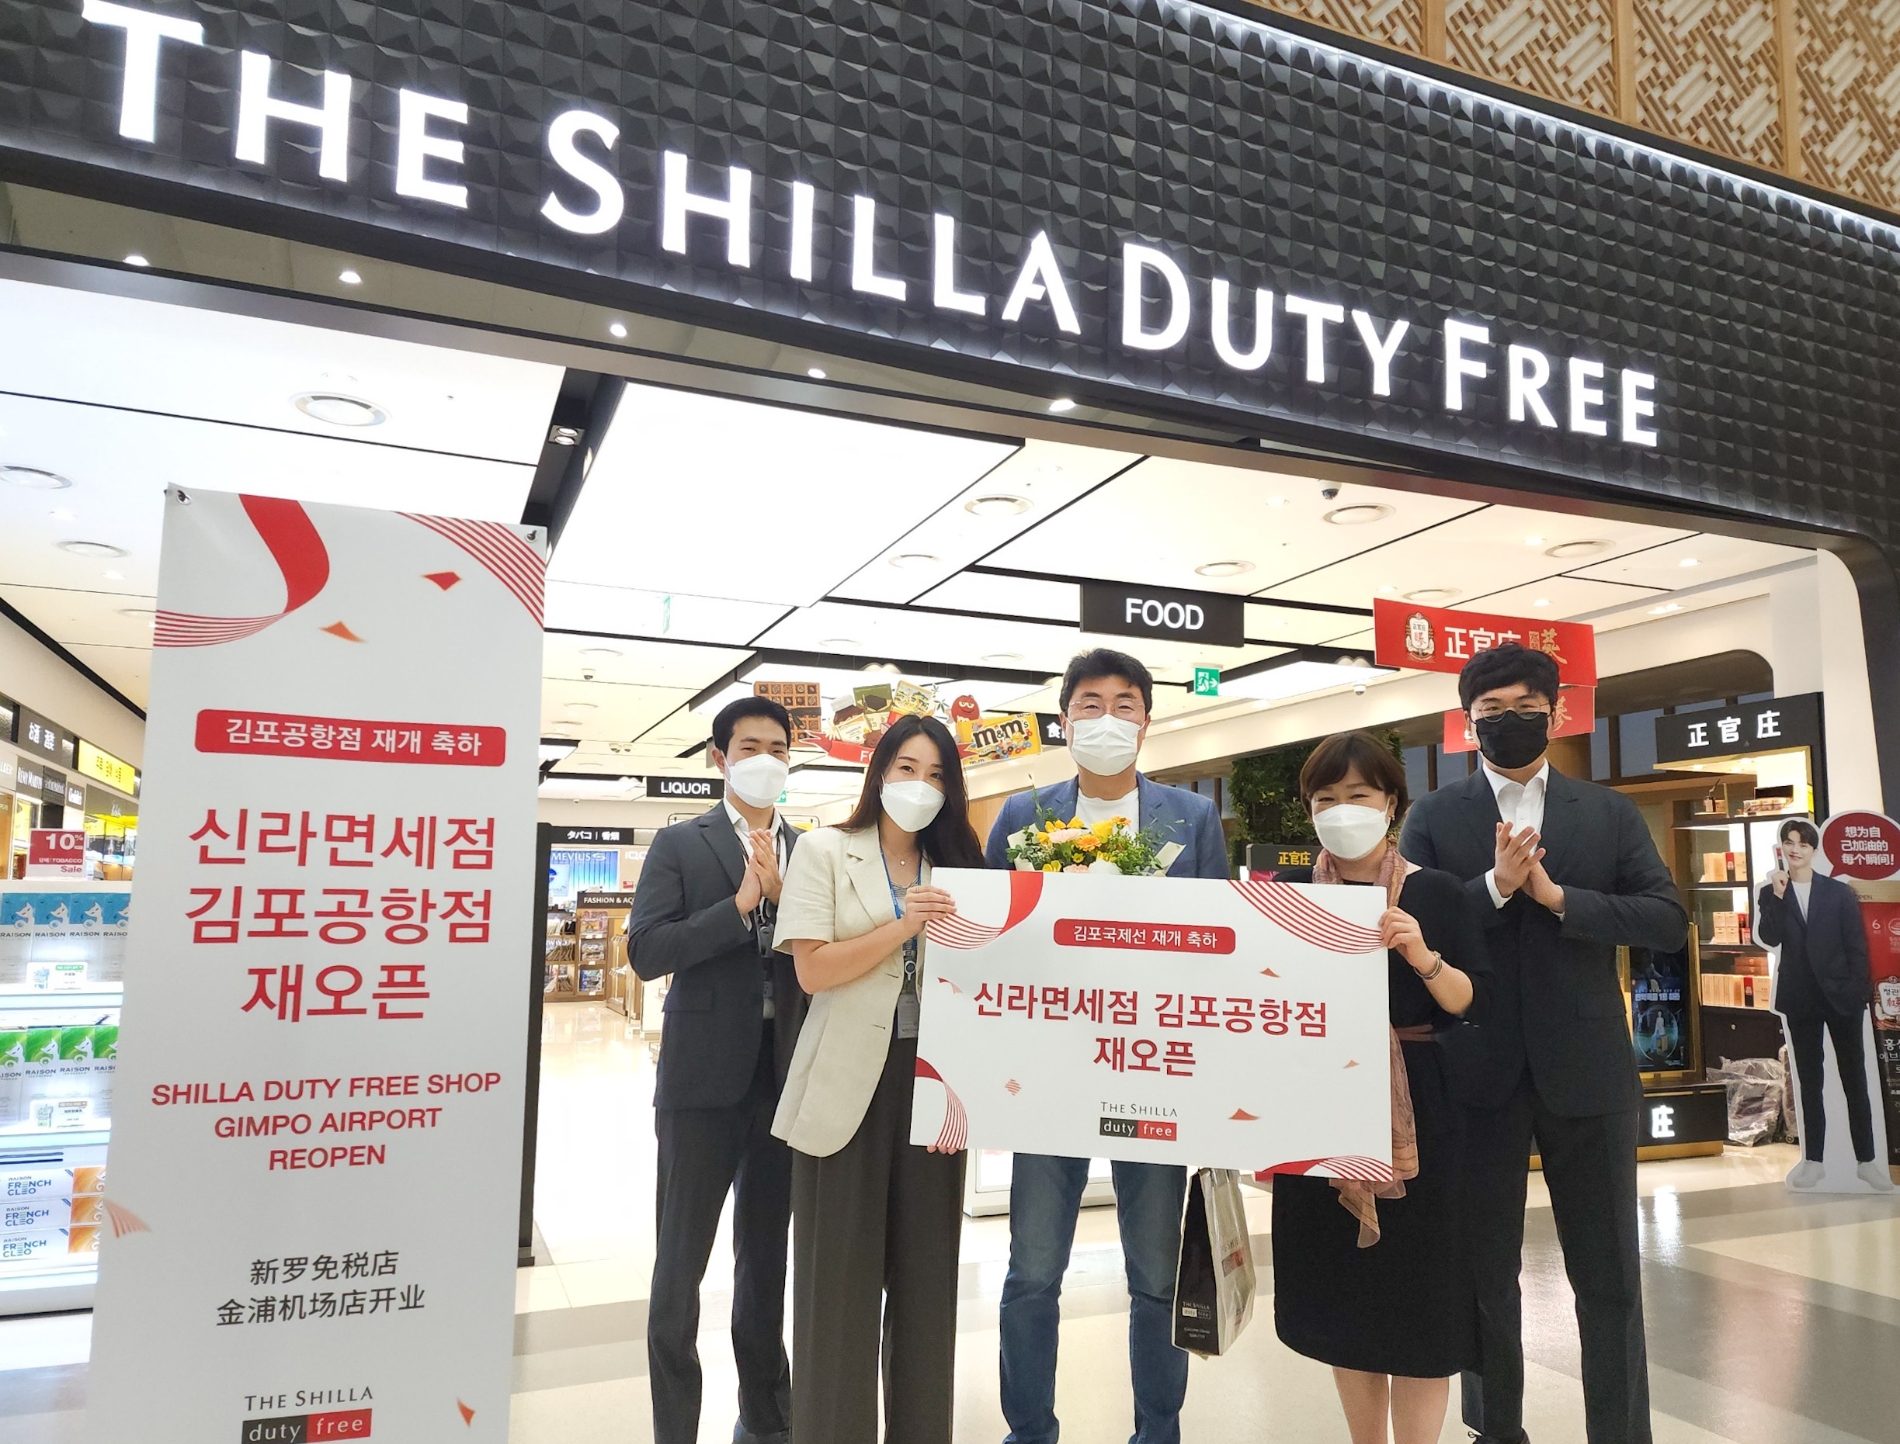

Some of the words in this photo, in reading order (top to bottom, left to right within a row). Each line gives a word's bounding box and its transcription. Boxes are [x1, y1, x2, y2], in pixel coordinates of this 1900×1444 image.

[82, 0, 468, 209] THE
[540, 110, 1082, 335] SHILLA
[1123, 243, 1410, 396] DUTY
[1444, 318, 1657, 447] FREE
[1125, 598, 1204, 631] FOOD
[226, 718, 362, 751] 김포공항점
[371, 728, 421, 754] 재개
[431, 731, 482, 757] 축하
[1046, 722, 1065, 739] 食
[1687, 710, 1781, 748] 正官庄
[661, 781, 711, 795] LIQUOR
[189, 808, 495, 870] 신라면세점
[567, 830, 592, 840] タバコ
[1845, 826, 1881, 838] 想为自
[1840, 840, 1888, 851] 己加油的
[551, 852, 591, 862] MEVIUS
[1841, 853, 1894, 865] 每个瞬间!
[185, 886, 492, 945] 김포공항점
[1872, 919, 1881, 929] 6
[1073, 926, 1146, 944] 김포국제선
[1152, 930, 1181, 946] 재개
[1186, 931, 1217, 948] 축하
[241, 964, 430, 1022] 재오픈
[973, 982, 1138, 1024] 신라면세점
[1154, 993, 1327, 1038] 김포공항점
[1884, 1039, 1900, 1051] 홍
[1094, 1037, 1196, 1077] 재오픈
[151, 1081, 254, 1106] SHILLA
[263, 1078, 341, 1102] DUTY
[349, 1075, 419, 1098] FREE
[427, 1072, 501, 1094] SHOP
[1101, 1102, 1125, 1113] THE
[1131, 1104, 1177, 1117] SHILLA
[214, 1113, 312, 1138] GIMPO
[319, 1107, 442, 1133] AIRPORT
[1104, 1120, 1135, 1137] duty
[1143, 1123, 1172, 1136] free
[269, 1144, 386, 1171] REOPEN
[7, 1179, 51, 1190] FRENCH
[7, 1188, 36, 1196] CLEO
[5, 1218, 34, 1227] CLEO
[6, 1210, 49, 1220] FRENCH
[3, 1240, 47, 1251] FRENCH
[3, 1248, 32, 1258] CLEO
[249, 1249, 399, 1287] 新罗免税店
[216, 1284, 426, 1327] 金浦机场店开业
[244, 1394, 287, 1411] THE
[294, 1386, 373, 1408] SHILLA
[248, 1420, 301, 1443] duty
[315, 1417, 363, 1436] free
